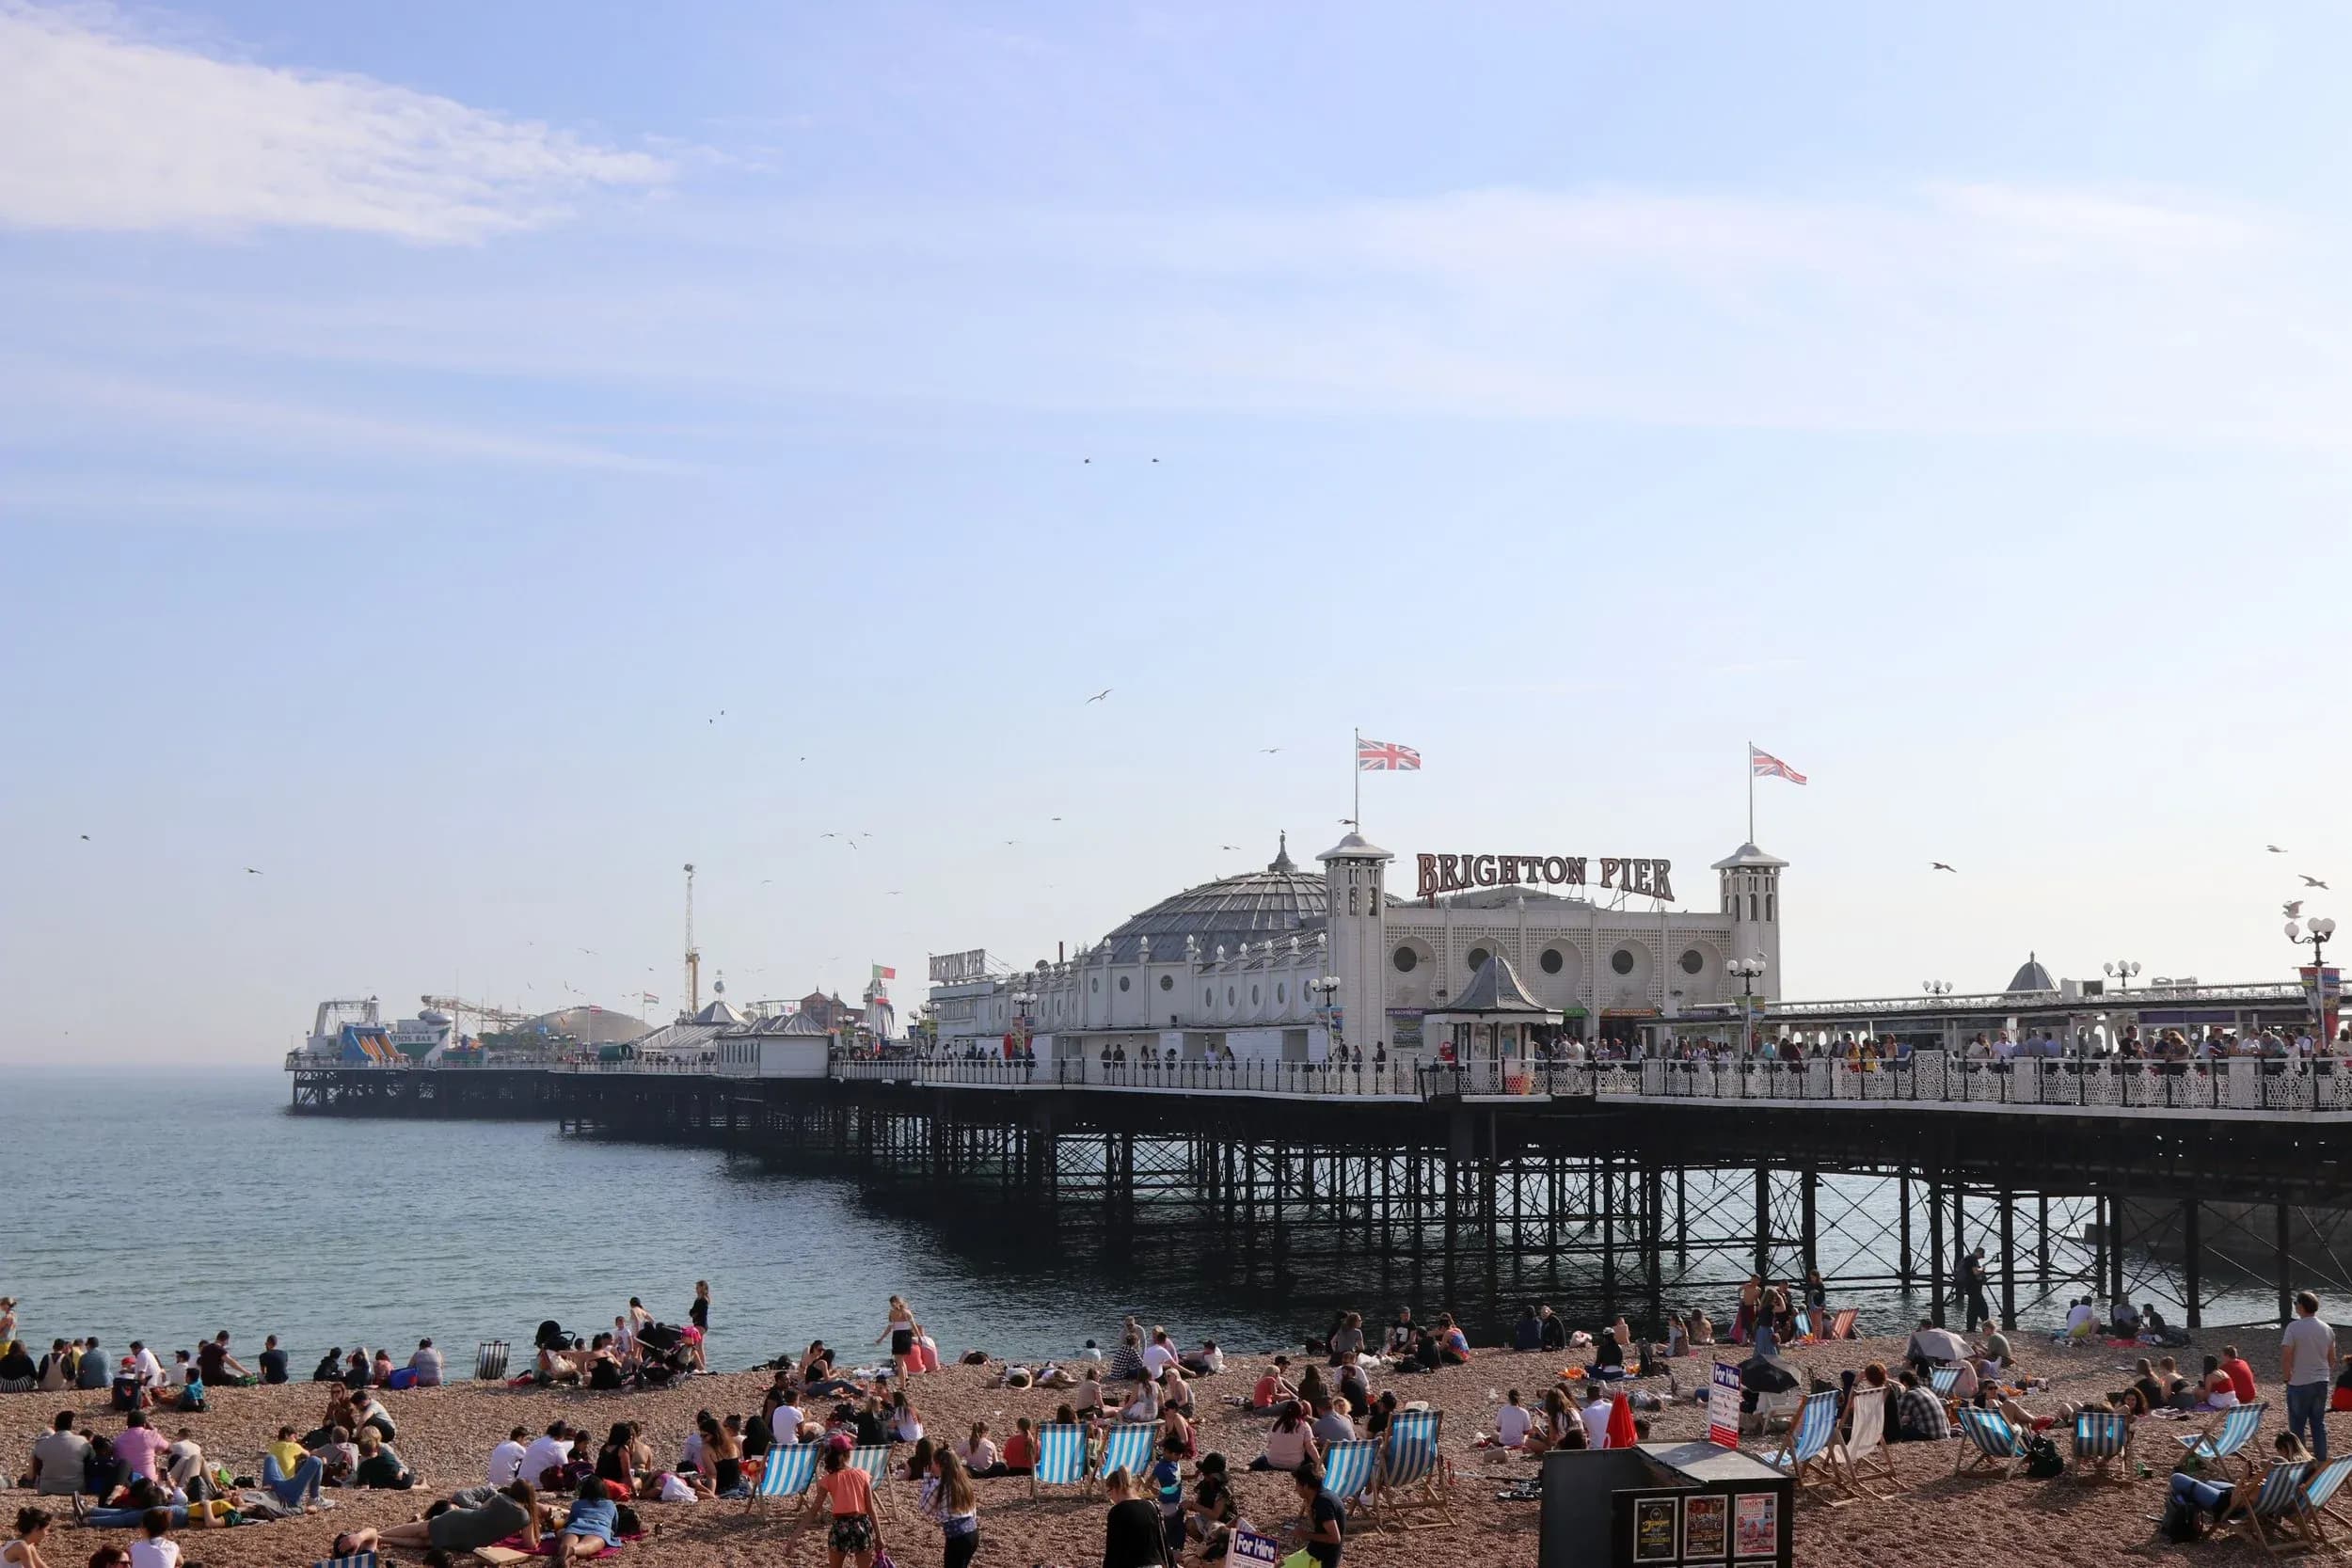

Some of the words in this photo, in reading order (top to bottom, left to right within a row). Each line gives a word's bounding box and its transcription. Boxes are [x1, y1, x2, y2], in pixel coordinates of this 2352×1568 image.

[1417, 853, 1587, 896] BRIGHTON
[1600, 858, 1675, 902] PIER
[930, 952, 966, 981] BRIGHTON
[967, 948, 986, 977] PIER
[1715, 1365, 1725, 1384] For
[1725, 1369, 1740, 1387] Hire
[1236, 1534, 1254, 1554] For
[1254, 1538, 1276, 1560] Hire
